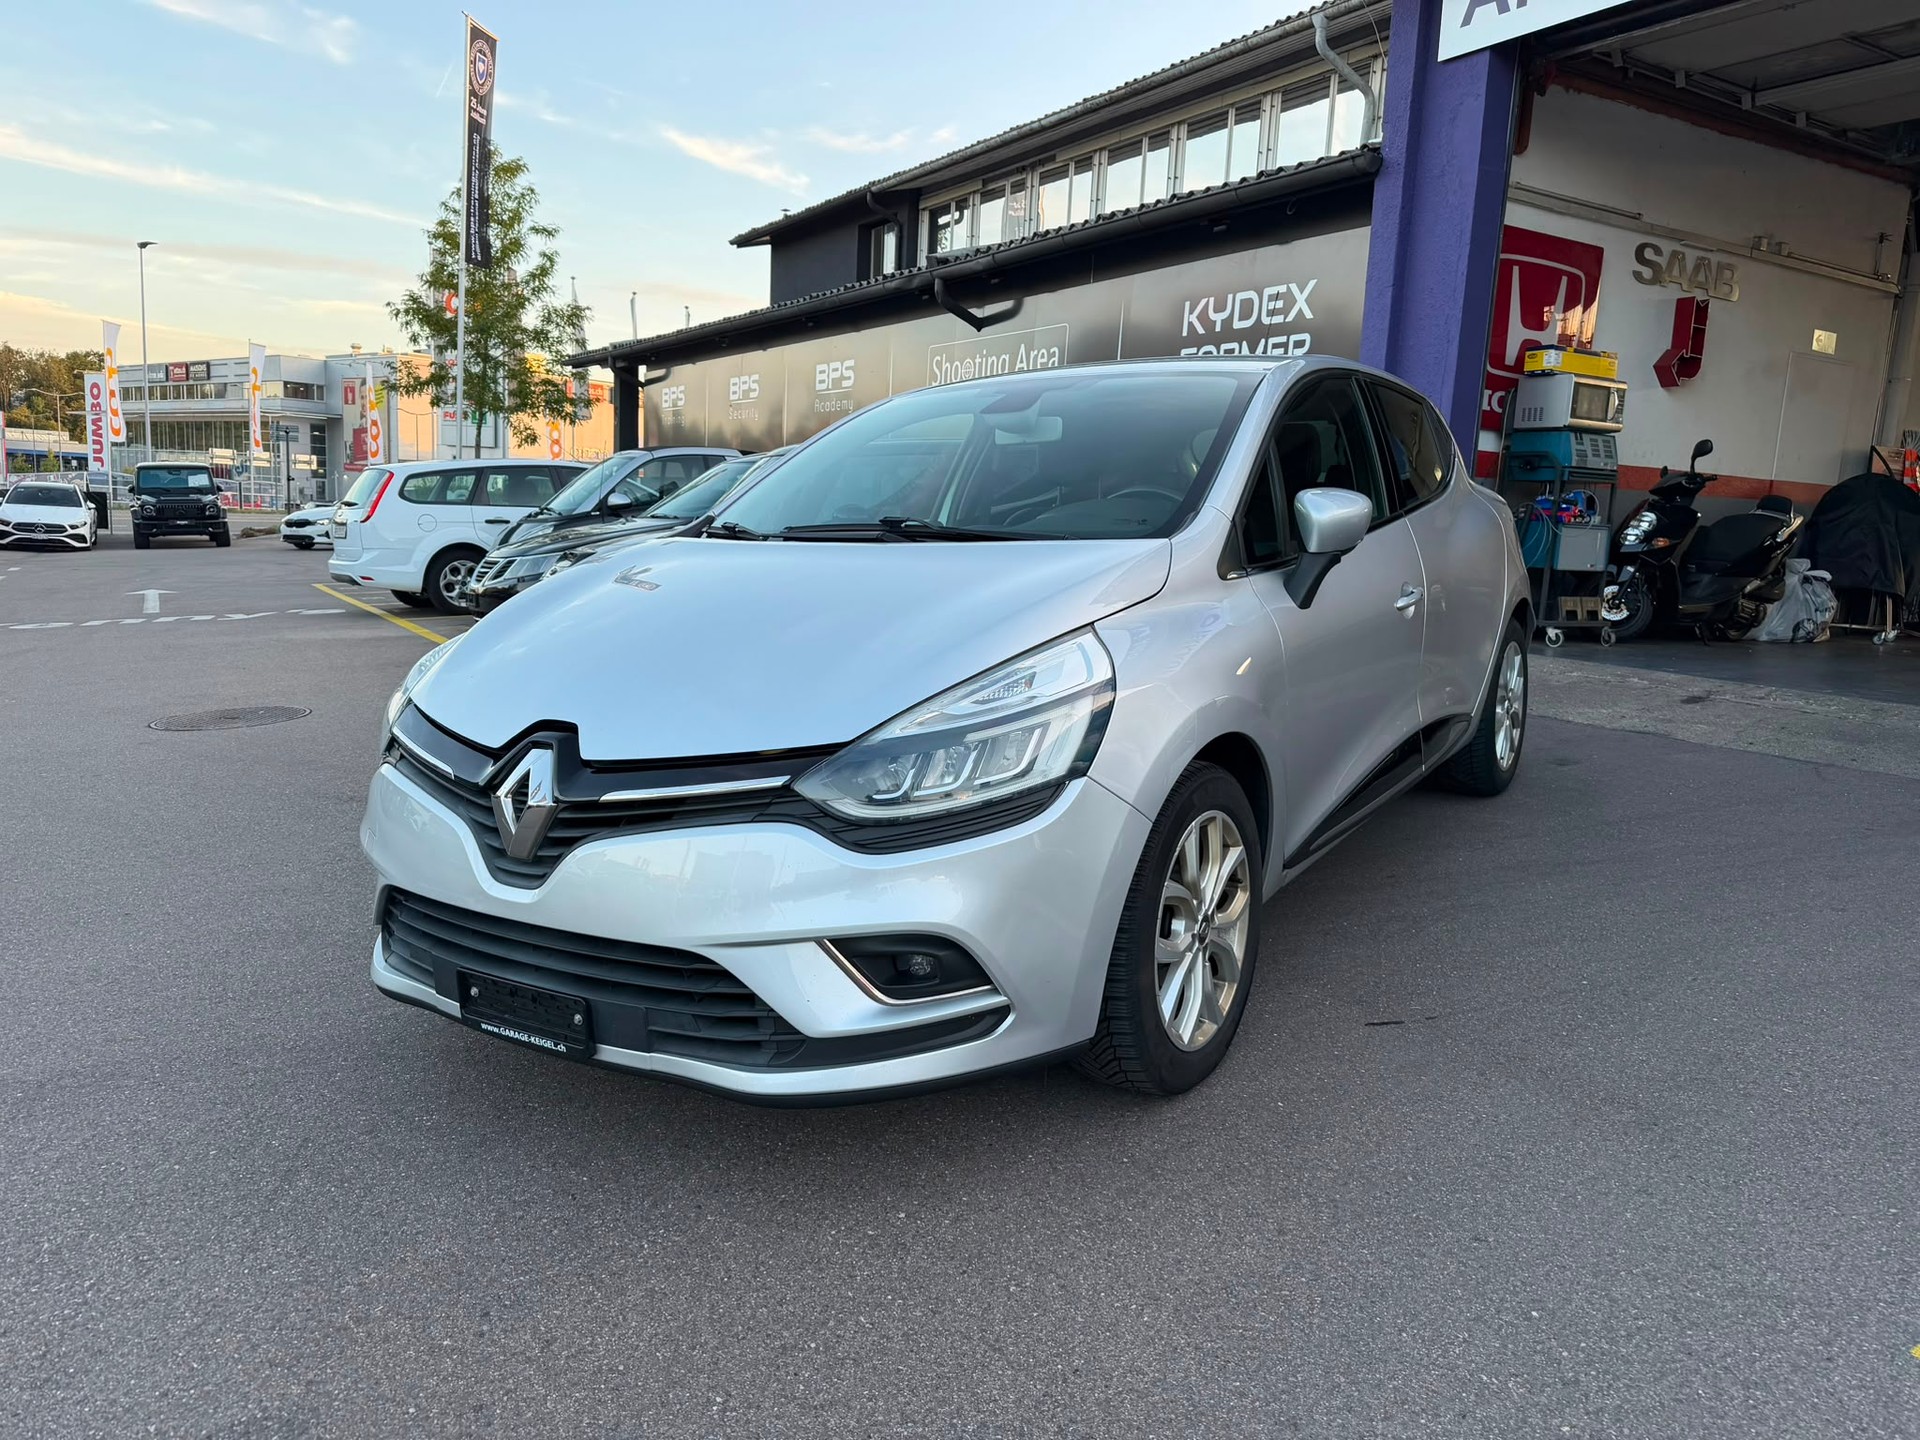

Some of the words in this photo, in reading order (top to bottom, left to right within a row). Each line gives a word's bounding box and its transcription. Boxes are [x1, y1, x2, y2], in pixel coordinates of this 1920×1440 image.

[1632, 242, 1740, 302] SAAB
[1182, 279, 1318, 337] KYDEX
[1014, 343, 1060, 371] Area
[728, 374, 760, 401] BPS
[814, 359, 856, 391] BPS
[661, 385, 686, 408] BPS
[813, 398, 854, 413] Academy
[89, 381, 105, 468] JUMBO
[728, 407, 759, 421] Security
[480, 1022, 567, 1053] www.GARAGE-KEIGEL.ch
